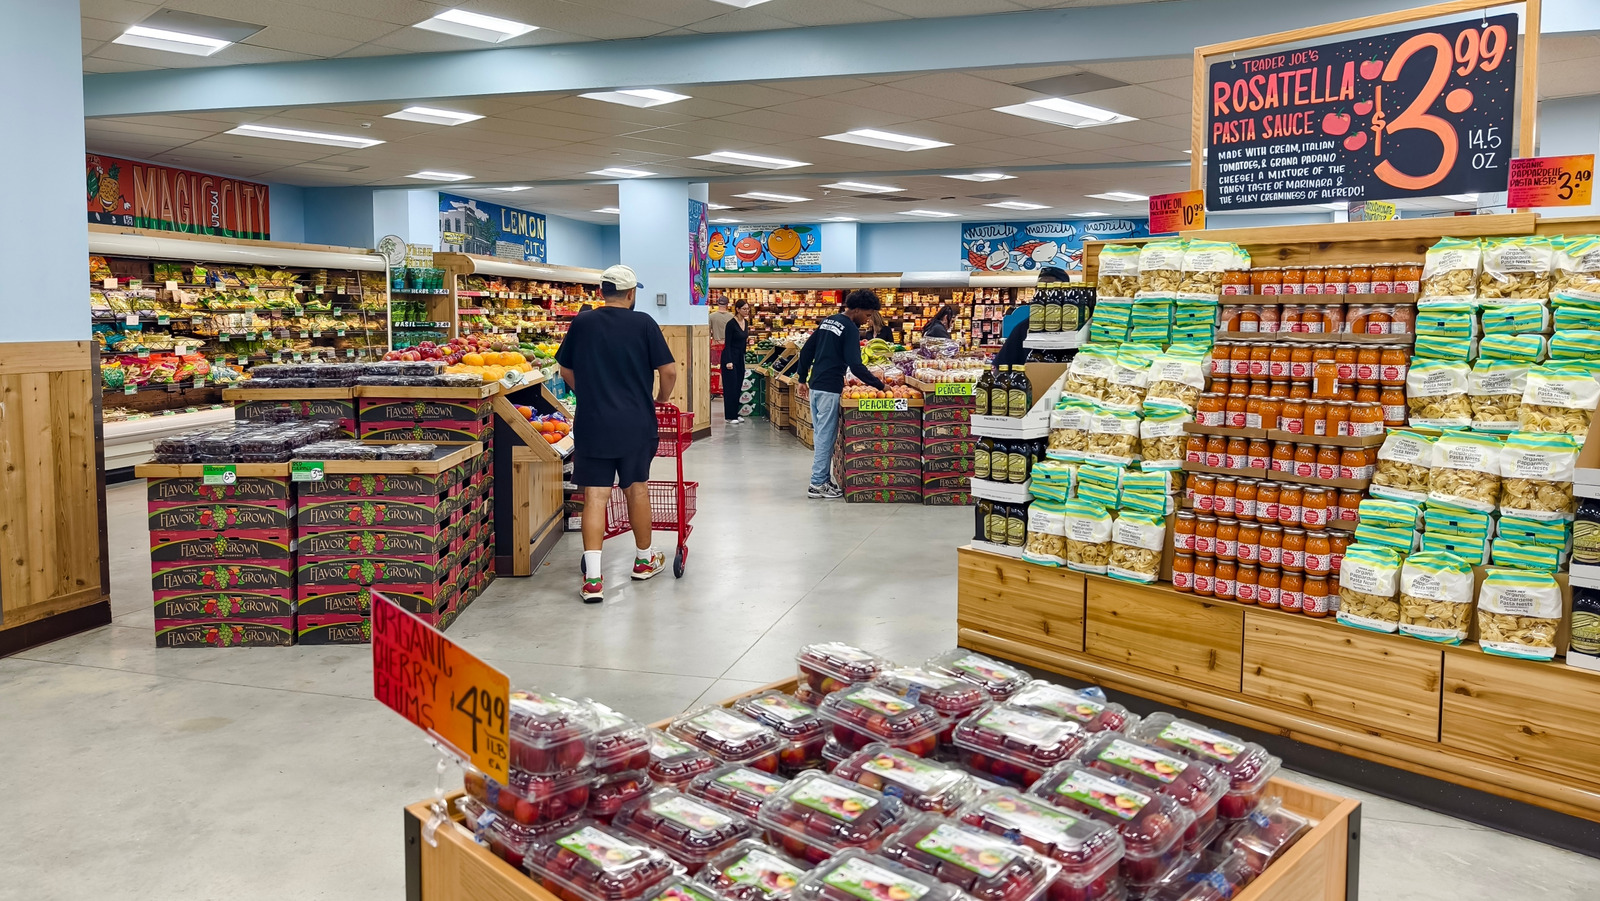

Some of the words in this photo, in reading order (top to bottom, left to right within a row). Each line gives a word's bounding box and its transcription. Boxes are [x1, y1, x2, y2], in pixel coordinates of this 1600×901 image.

[1242, 56, 1286, 73] TRADER
[1289, 50, 1319, 66] JOE'S
[1214, 60, 1354, 117] ROSATELLA
[1214, 118, 1256, 145] PASTA
[1262, 110, 1314, 140] SAUCE
[1468, 126, 1502, 150] 14.5
[1218, 149, 1242, 160] MADE
[1245, 146, 1266, 158] WITH
[1270, 142, 1301, 154] CREAM,
[1302, 140, 1335, 152] ITALIAN
[1270, 156, 1298, 167] GRANA
[1301, 152, 1337, 163] PADANO
[1472, 152, 1498, 170] OZ
[1512, 161, 1544, 170] ORGANIC
[1219, 173, 1254, 185] CHEESE!
[1258, 171, 1264, 180] A
[1268, 168, 1309, 180] MIXTURE
[1312, 166, 1324, 176] OF
[1328, 164, 1346, 174] THE
[1512, 167, 1563, 178] PAPPARDELLE
[1219, 186, 1244, 194] TANGY
[1248, 182, 1272, 192] TASTE
[1274, 180, 1284, 190] OF
[1286, 178, 1333, 189] MARINARA
[1336, 176, 1344, 186] &
[1510, 178, 1532, 188] PASTA
[1534, 176, 1556, 186] NESTS
[133, 165, 214, 236] MAGIC
[220, 178, 267, 240] CITY
[1219, 196, 1232, 205] THE
[1236, 194, 1258, 204] SILKY
[1260, 190, 1306, 202] CREAMINESS
[1308, 190, 1318, 199] OF
[1322, 185, 1365, 198] ALFREDO!
[210, 190, 220, 228] 305
[1150, 200, 1172, 210] OLIVE
[1173, 198, 1182, 208] OIL
[501, 208, 545, 240] LEMON
[1026, 222, 1076, 242] merrily
[1084, 220, 1140, 238] merrily
[964, 223, 1018, 248] merrily
[524, 240, 544, 258] CITY
[938, 386, 966, 395] PEACHES
[312, 404, 344, 416] GROWN
[386, 406, 414, 418] FLAVOR
[424, 406, 454, 417] GROWN
[160, 482, 194, 498] FLAVOR
[238, 482, 276, 496] GROWN
[310, 479, 344, 494] FLAVOR
[387, 479, 423, 493] GROWN
[160, 512, 196, 528] FLAVOR
[239, 511, 276, 526] GROWN
[310, 508, 345, 524] FLAVOR
[387, 508, 422, 522] GROWN
[181, 542, 214, 558] FLAVOR
[224, 542, 260, 556] GROWN
[310, 538, 345, 552] FLAVOR
[387, 538, 422, 552] GROWN
[164, 573, 198, 588] FLAVOR
[241, 572, 278, 586] GROWN
[310, 566, 344, 582] FLAVOR
[386, 565, 422, 580] GROWN
[166, 602, 200, 616] FLAVOR
[243, 600, 280, 614] GROWN
[325, 596, 358, 610] FLAVOR
[168, 631, 202, 646] FLAVOR
[244, 630, 280, 643] GROWN
[328, 626, 360, 641] FLAVOR
[374, 600, 452, 678] ORGANIC
[373, 636, 438, 703] CHERRY
[376, 670, 435, 731] PLUMS
[488, 758, 502, 772] EA
